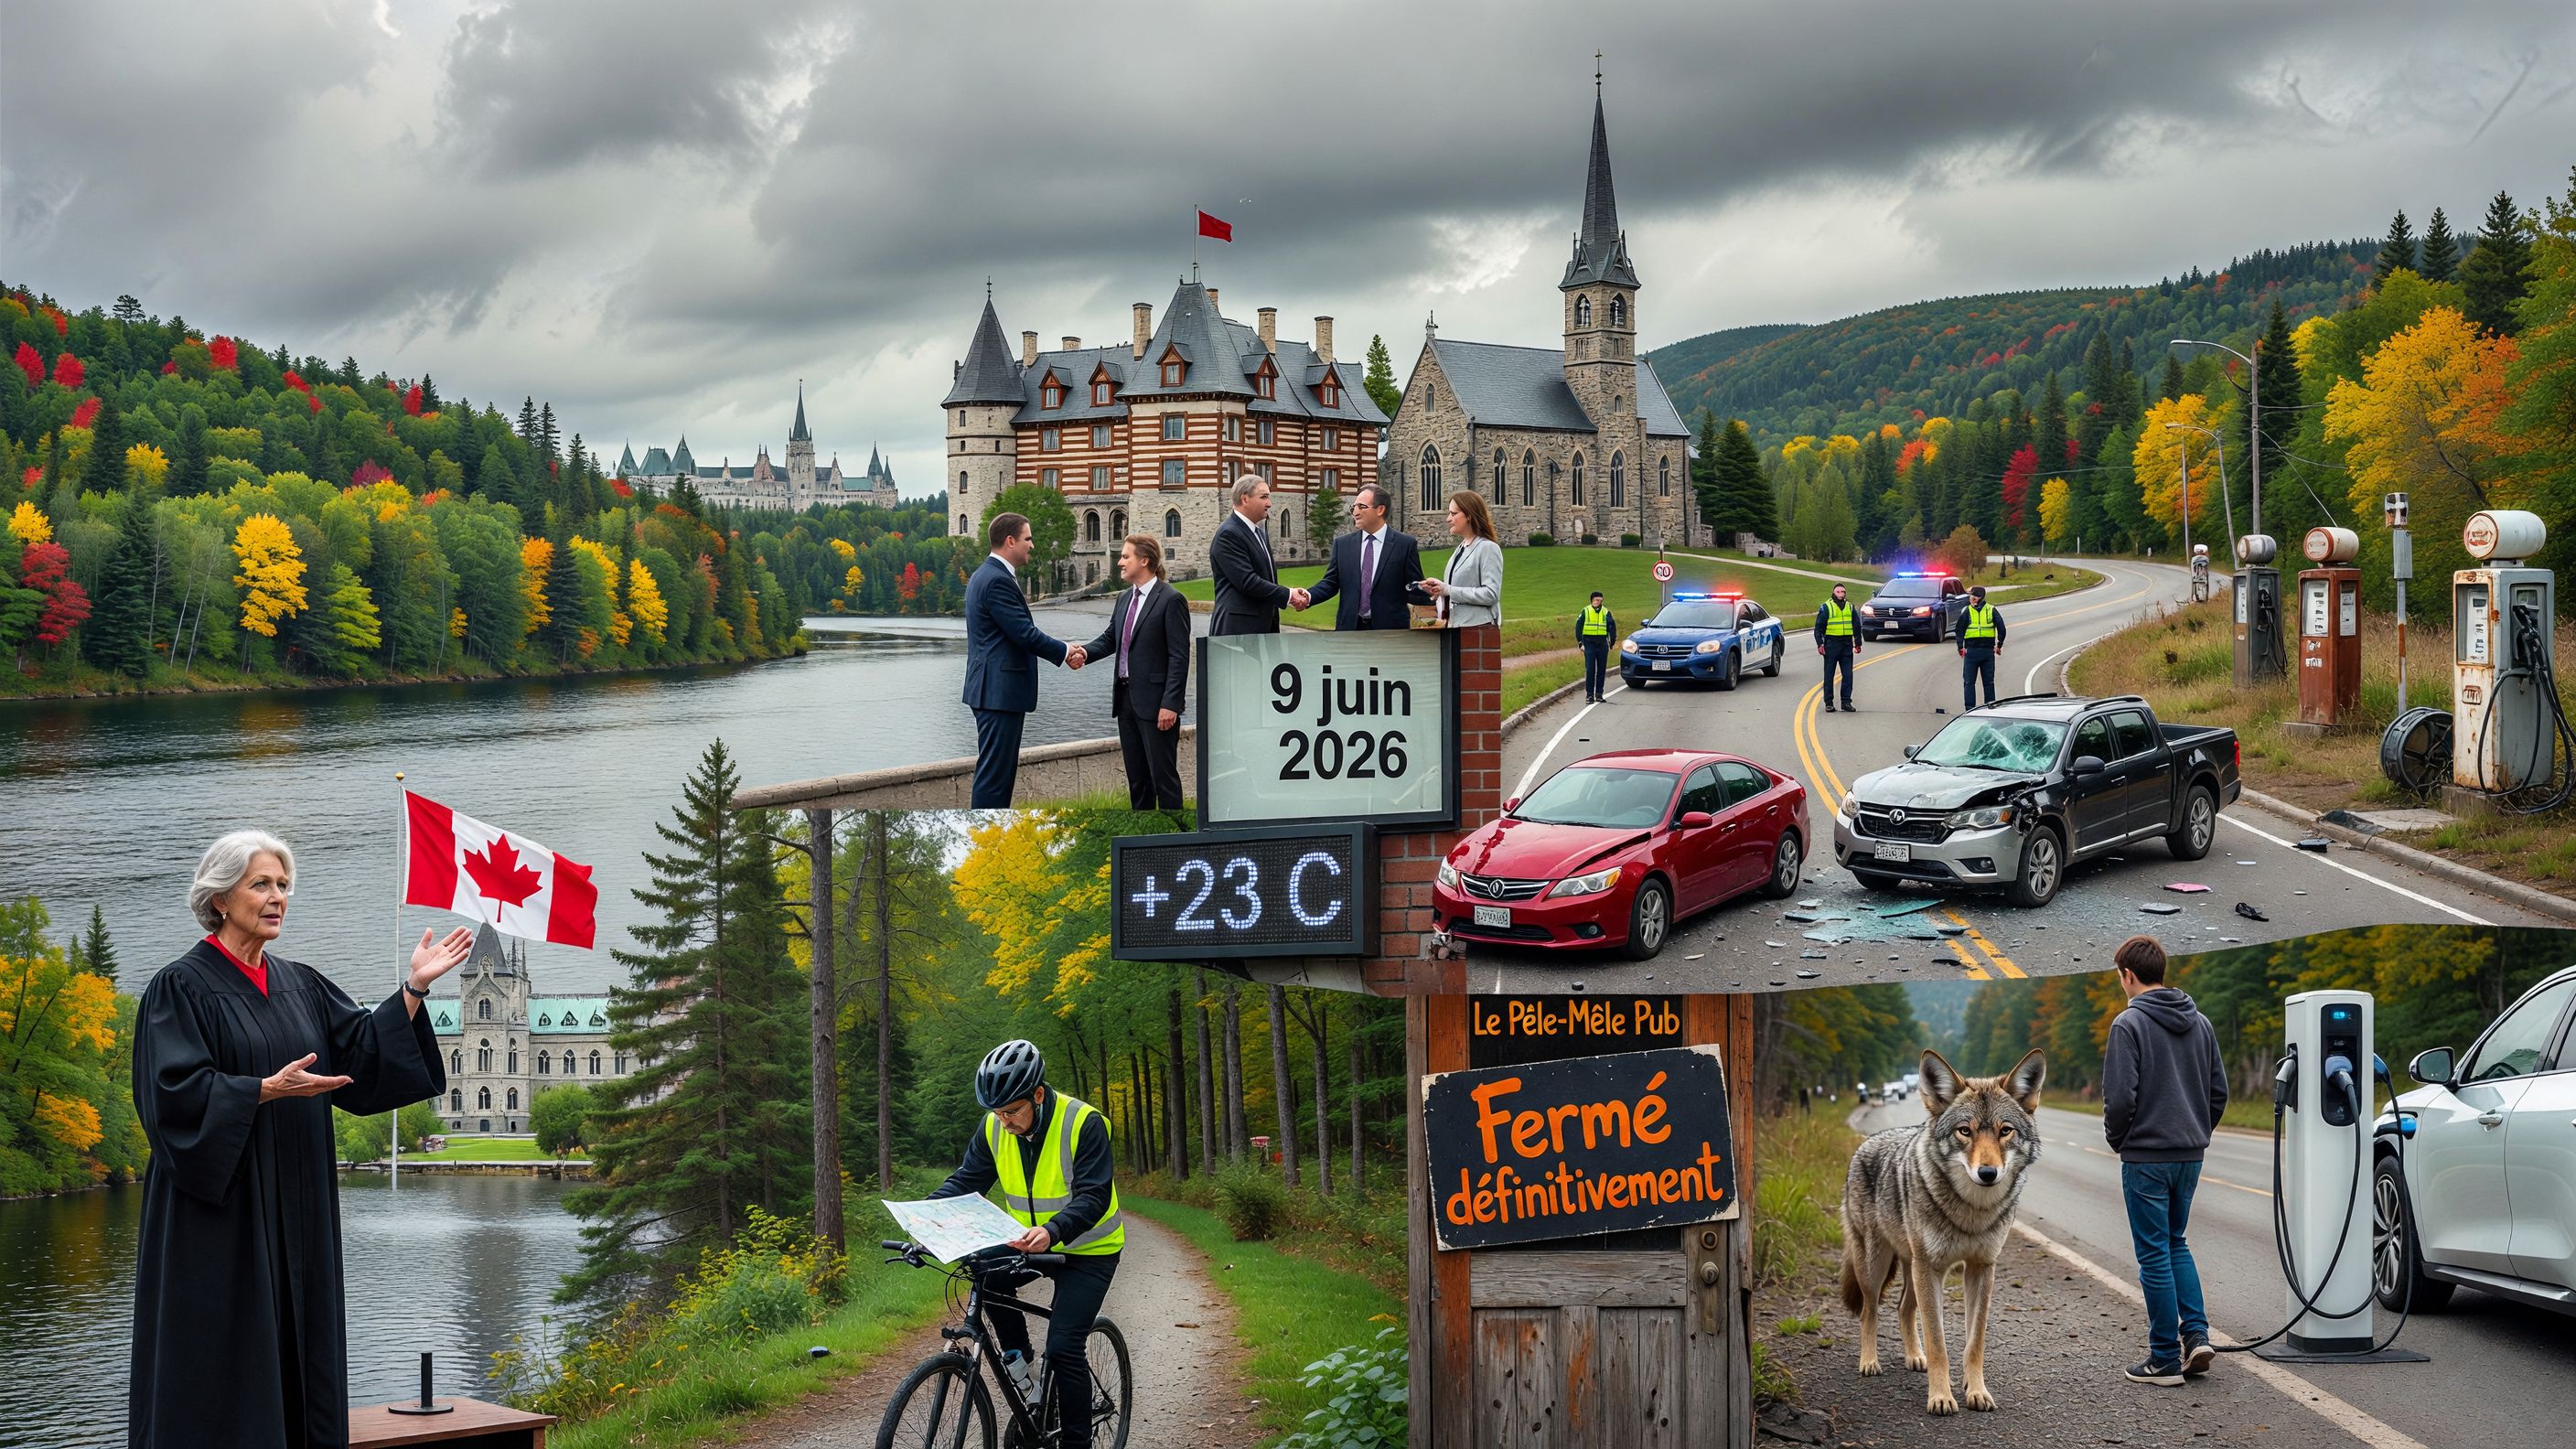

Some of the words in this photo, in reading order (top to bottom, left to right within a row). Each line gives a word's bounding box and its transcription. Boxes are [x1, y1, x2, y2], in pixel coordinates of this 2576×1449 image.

[1271, 662, 1303, 715] 9
[1316, 664, 1411, 726] juin
[1279, 729, 1408, 780] 2026
[1132, 857, 1262, 931] +23
[1289, 852, 1342, 927] C
[1474, 1001, 1502, 1036] Le
[1508, 999, 1626, 1036] Pêle-Mêle
[1634, 999, 1680, 1036] Pub
[1470, 1070, 1672, 1165] Fermé
[1445, 1141, 1724, 1227] définitivement
